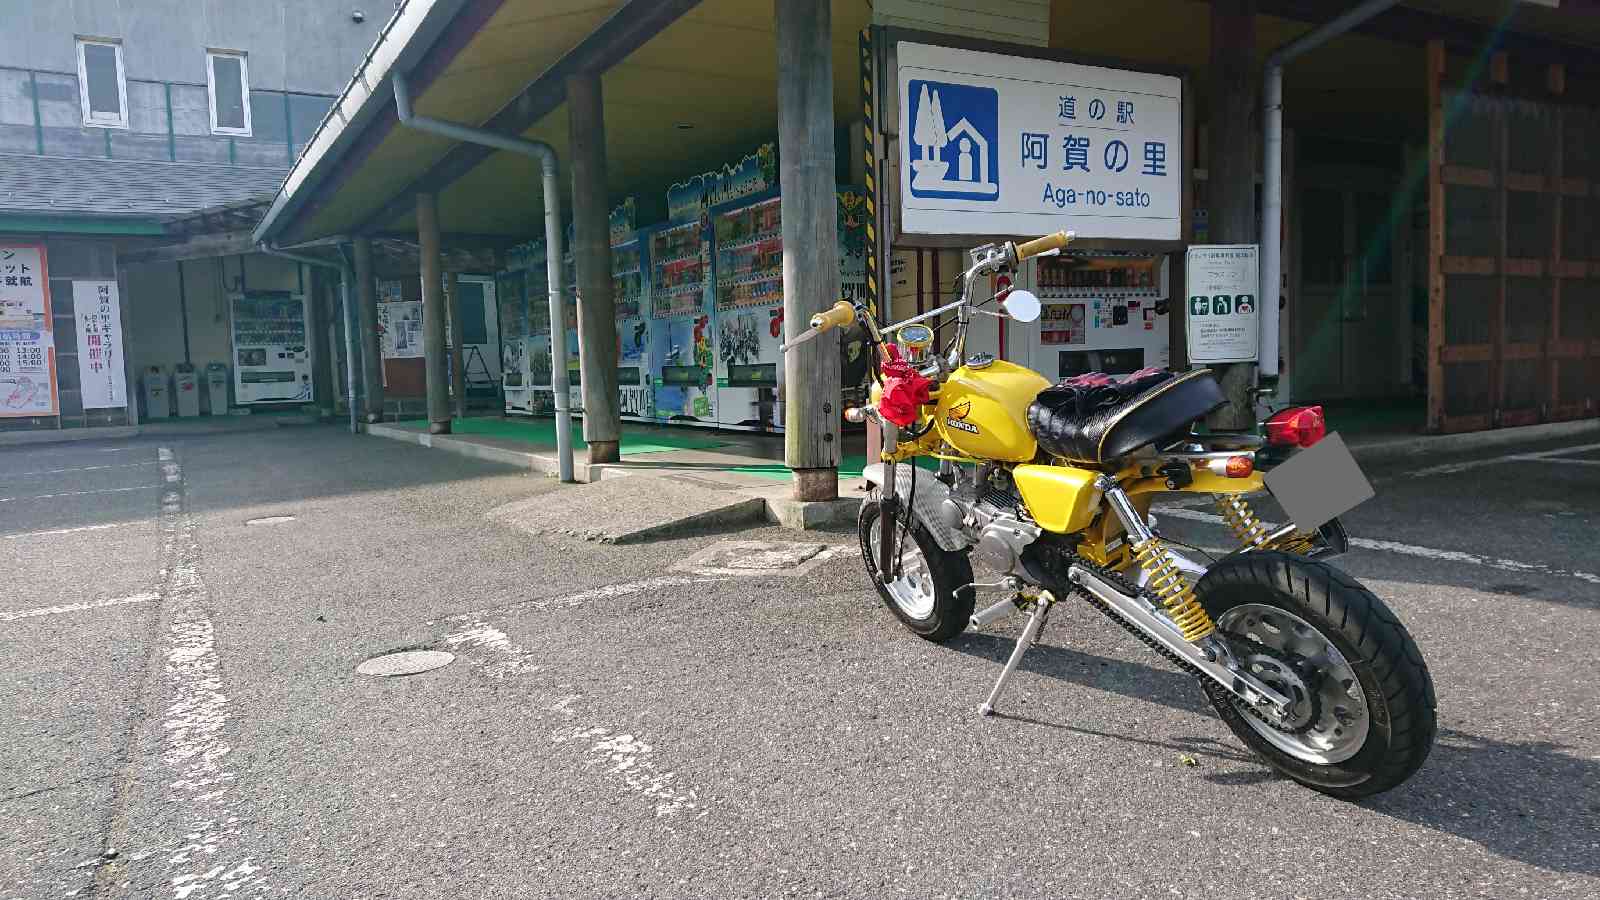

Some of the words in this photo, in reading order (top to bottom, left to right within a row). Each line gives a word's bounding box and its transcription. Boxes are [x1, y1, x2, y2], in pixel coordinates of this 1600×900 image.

[1058, 95, 1135, 125] 道の駅
[1021, 132, 1168, 177] 阿賀の里
[1042, 182, 1151, 209] Aga-no-sato
[0, 263, 31, 274] ット
[0, 275, 33, 287] 就航
[948, 418, 978, 433] HONDA
